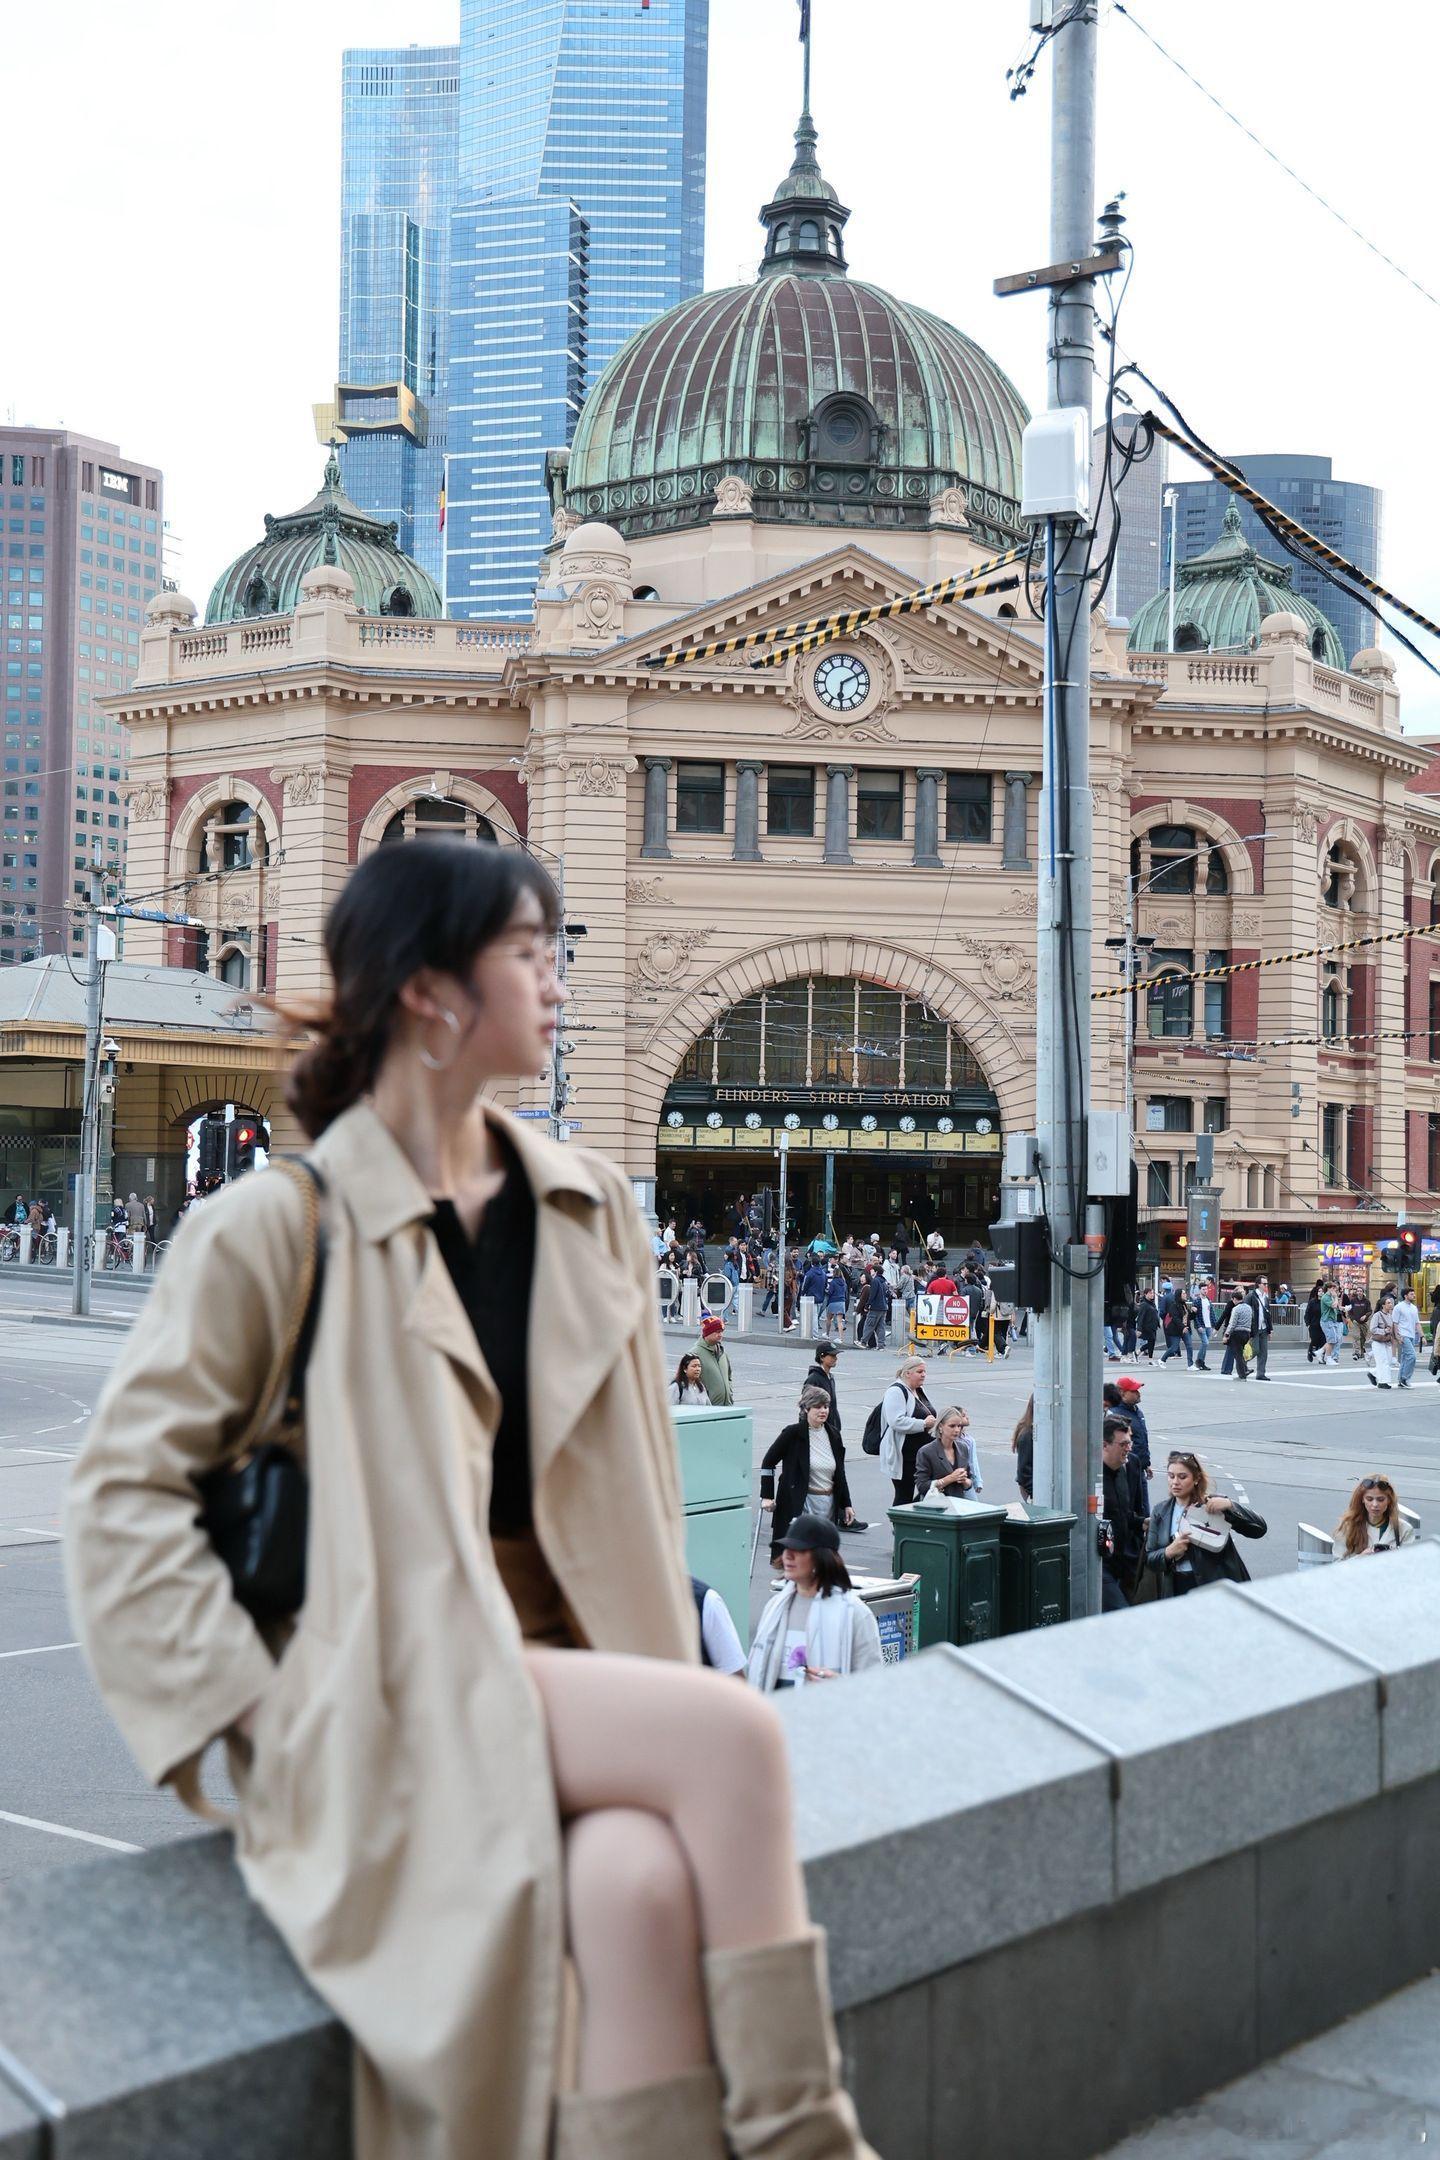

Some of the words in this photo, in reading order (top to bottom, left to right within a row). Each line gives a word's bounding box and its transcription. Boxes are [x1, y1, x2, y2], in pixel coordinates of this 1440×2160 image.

[103, 472, 129, 493] IBM
[716, 1089, 789, 1102] FLINDERS
[809, 1092, 865, 1104] STREET
[883, 1093, 950, 1106] STATION
[1233, 1238, 1270, 1248] HATTERS
[1333, 1244, 1361, 1260] EzyMart
[947, 1313, 966, 1321] ENTRY
[933, 1328, 967, 1337] DETOUR
